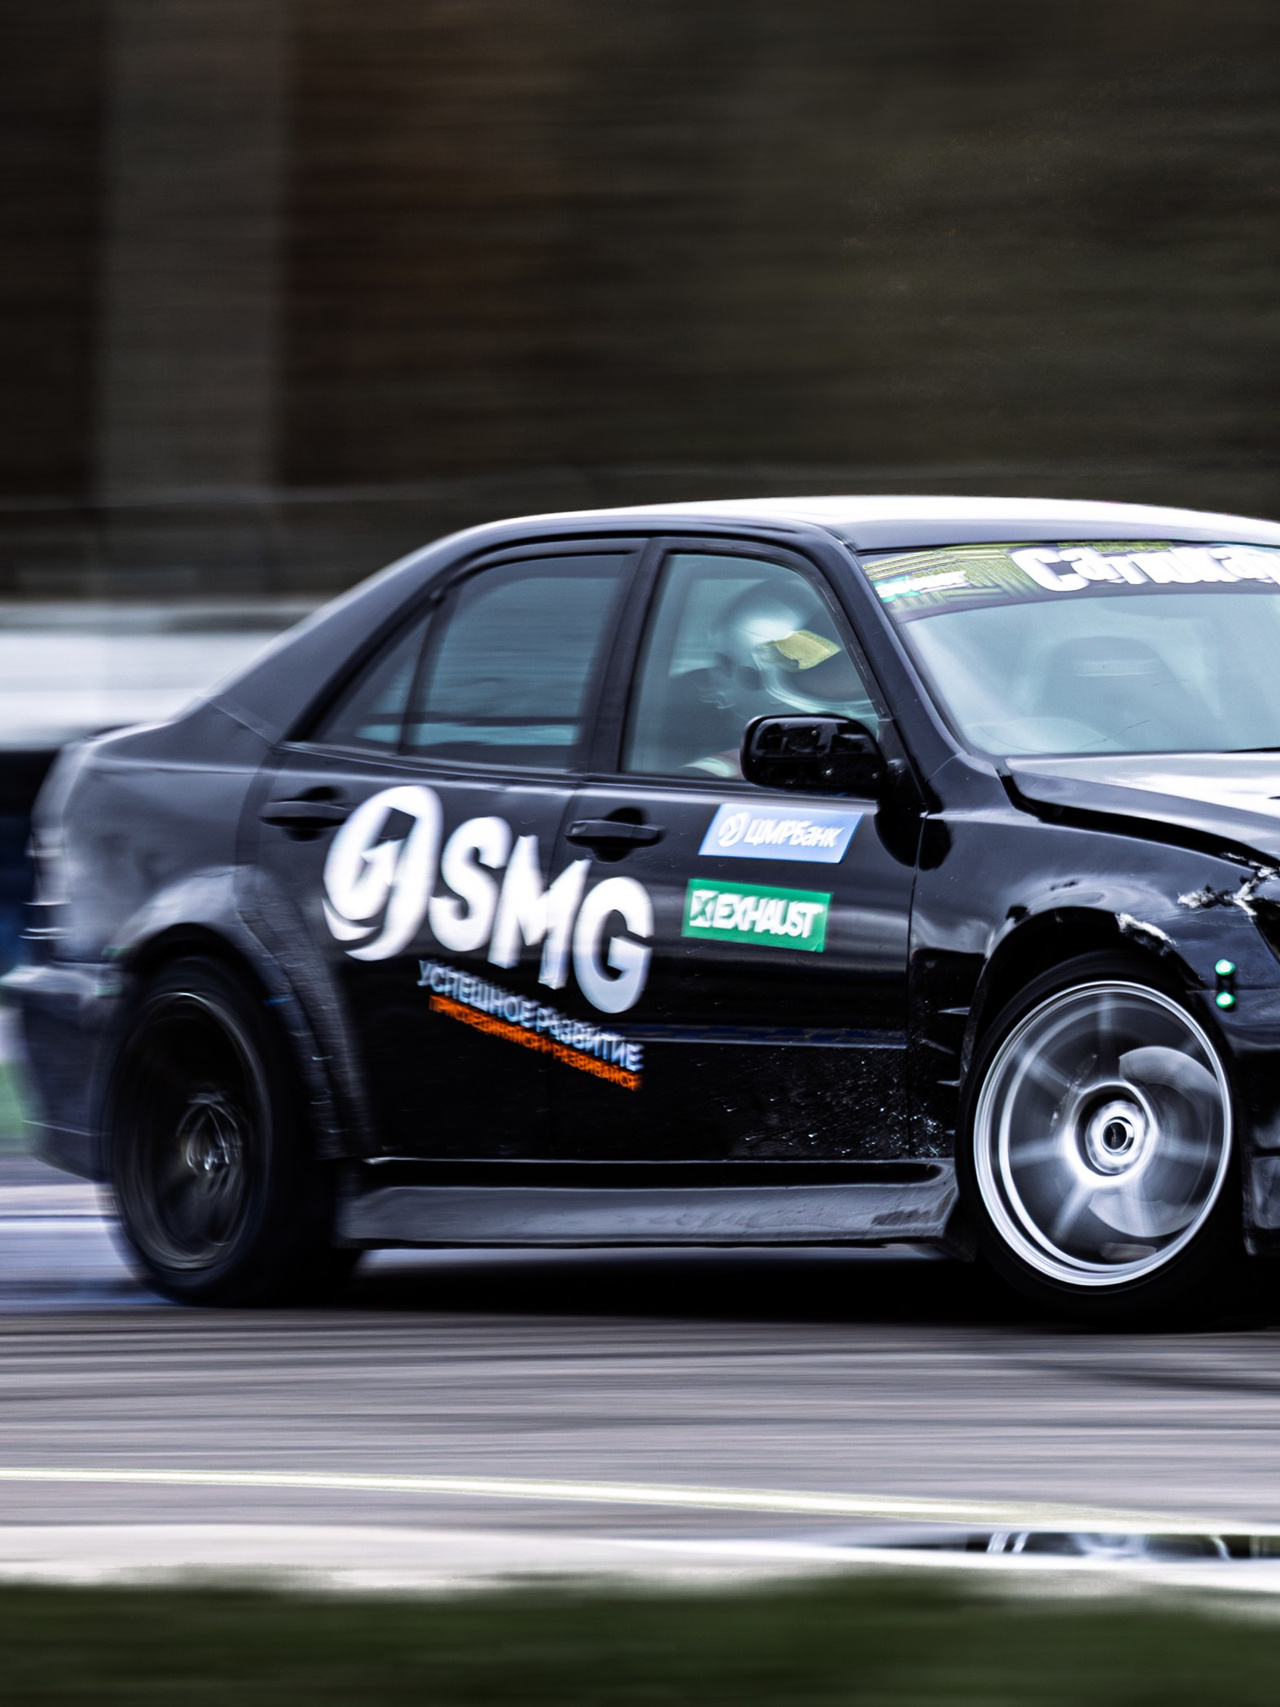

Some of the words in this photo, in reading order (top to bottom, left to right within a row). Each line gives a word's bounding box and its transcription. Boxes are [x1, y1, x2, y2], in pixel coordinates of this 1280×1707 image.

[744, 817, 845, 848] ЦМРБанк
[429, 816, 654, 1013] SMG
[417, 959, 539, 1029] УСПЕШНОЕ
[536, 1005, 644, 1072] РАЗВИТИЕ
